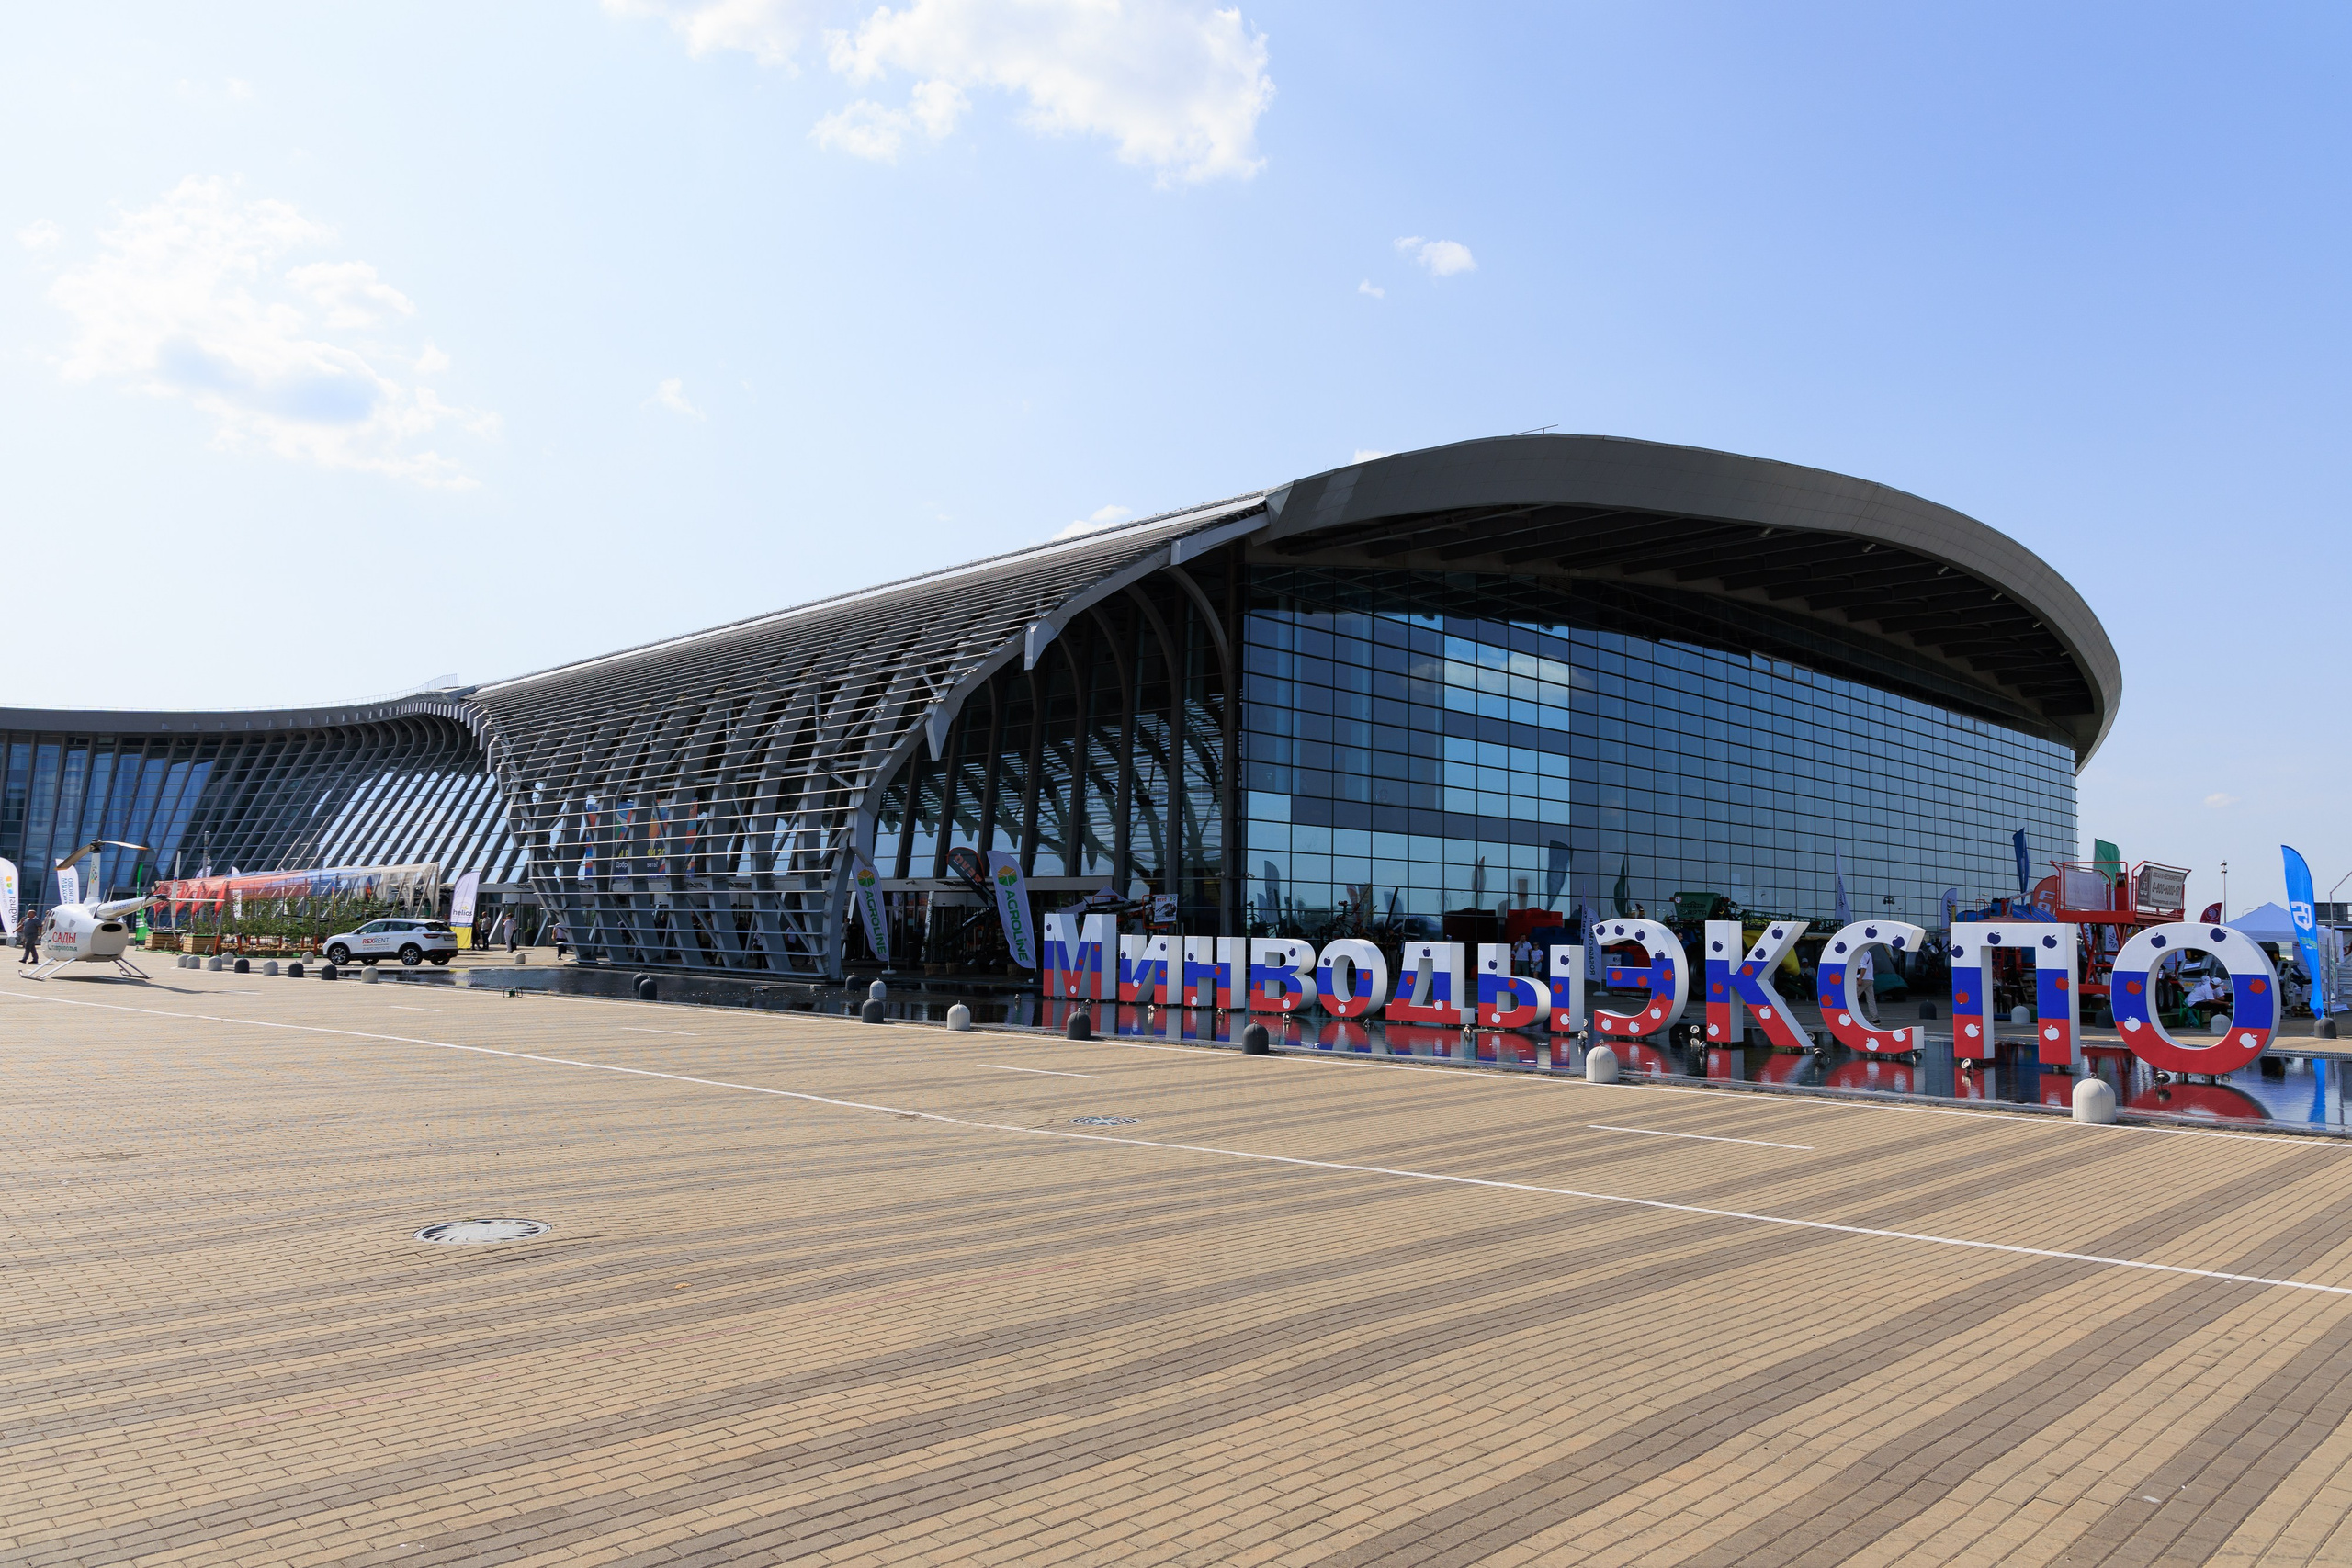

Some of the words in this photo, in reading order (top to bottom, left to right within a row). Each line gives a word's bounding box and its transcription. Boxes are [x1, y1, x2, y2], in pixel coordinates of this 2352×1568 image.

[453, 908, 473, 917] helios
[52, 931, 76, 944] САДЫ
[362, 937, 390, 945] REXRENT
[48, 939, 78, 953] Ставрополья
